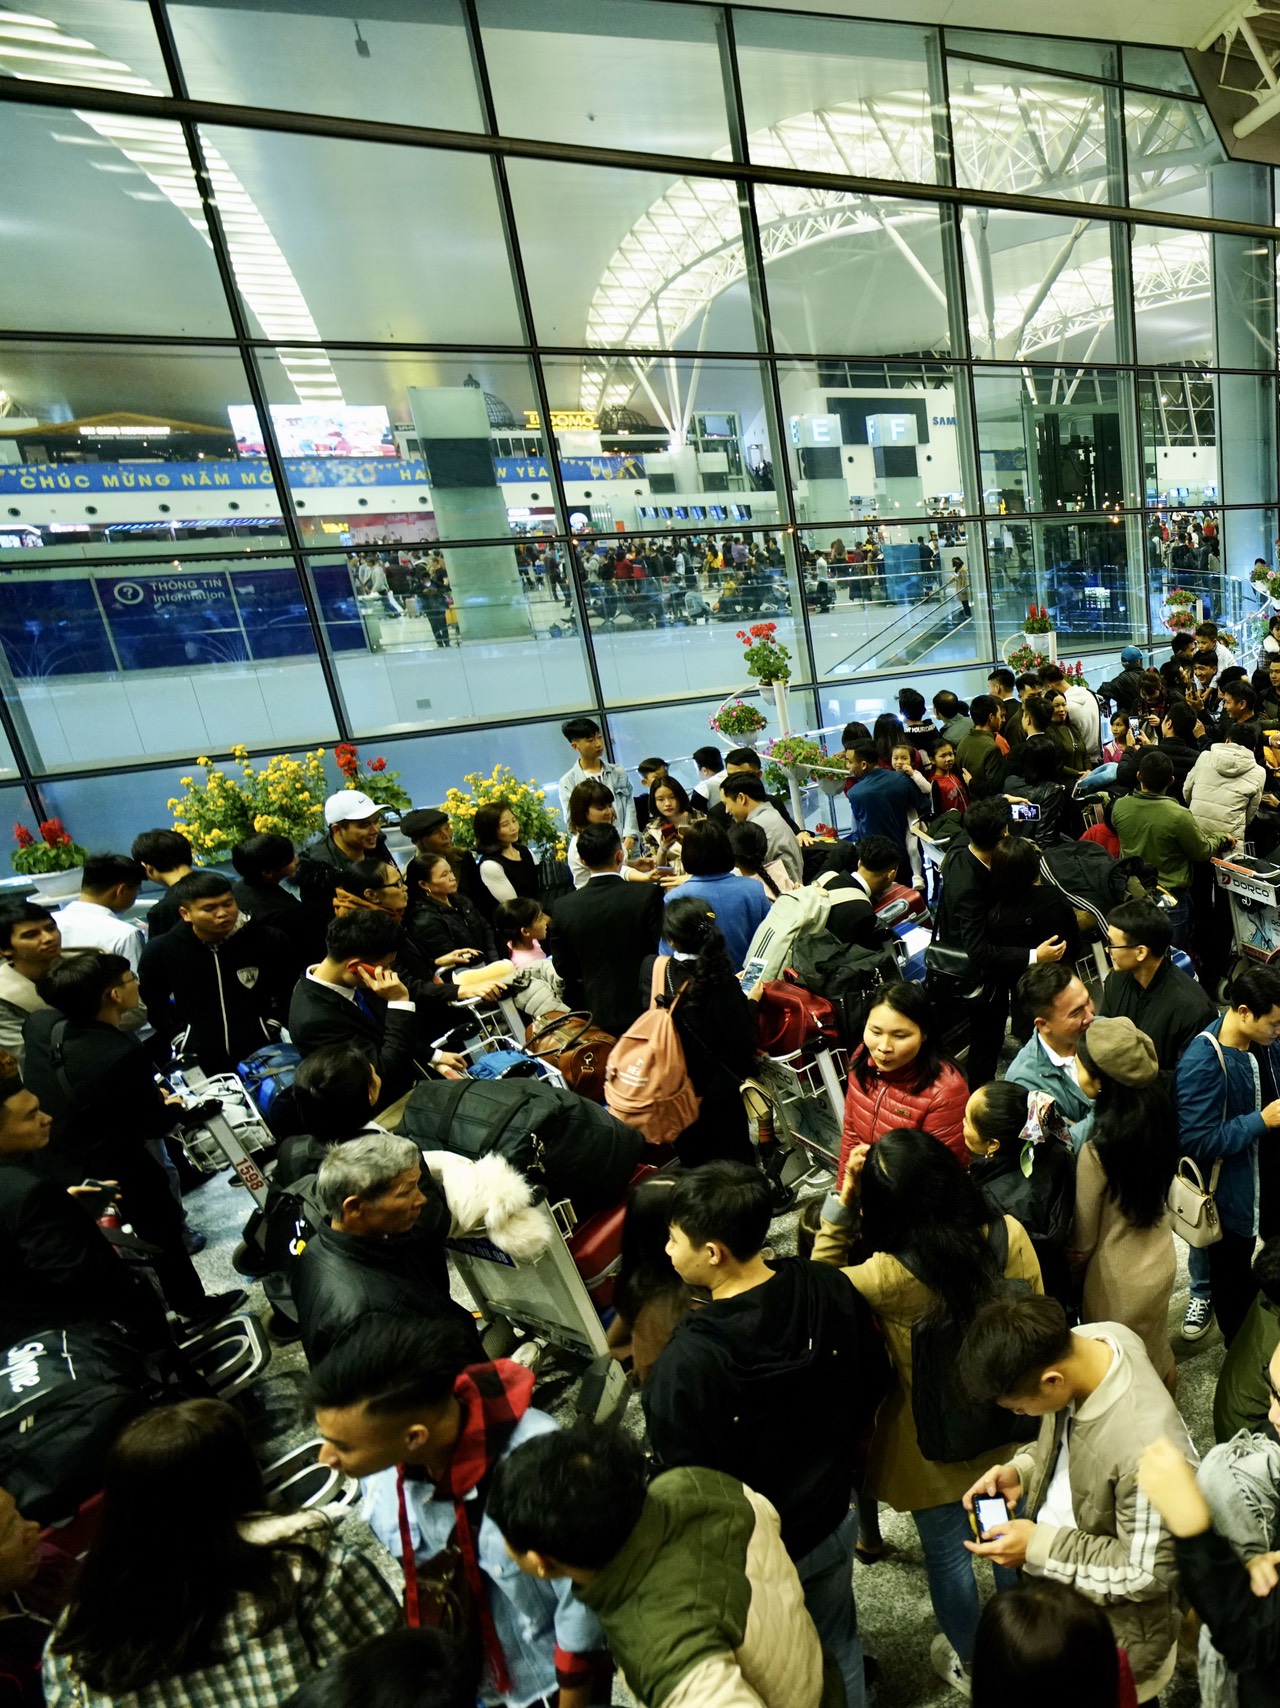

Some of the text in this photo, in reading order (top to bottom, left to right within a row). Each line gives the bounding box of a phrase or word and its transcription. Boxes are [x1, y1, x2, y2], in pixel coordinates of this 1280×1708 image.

[811, 419, 831, 442] E
[890, 418, 905, 441] F
[933, 416, 957, 426] SAM
[20, 474, 91, 489] CHÚC
[102, 473, 171, 488] MỪNG
[182, 472, 230, 486] NĂM
[241, 471, 275, 486] MỚ
[516, 466, 549, 479] YEA
[150, 578, 223, 592] THÔNG TIN
[153, 589, 226, 603] Information
[1232, 878, 1270, 898] DORCO
[236, 1157, 265, 1191] 1598
